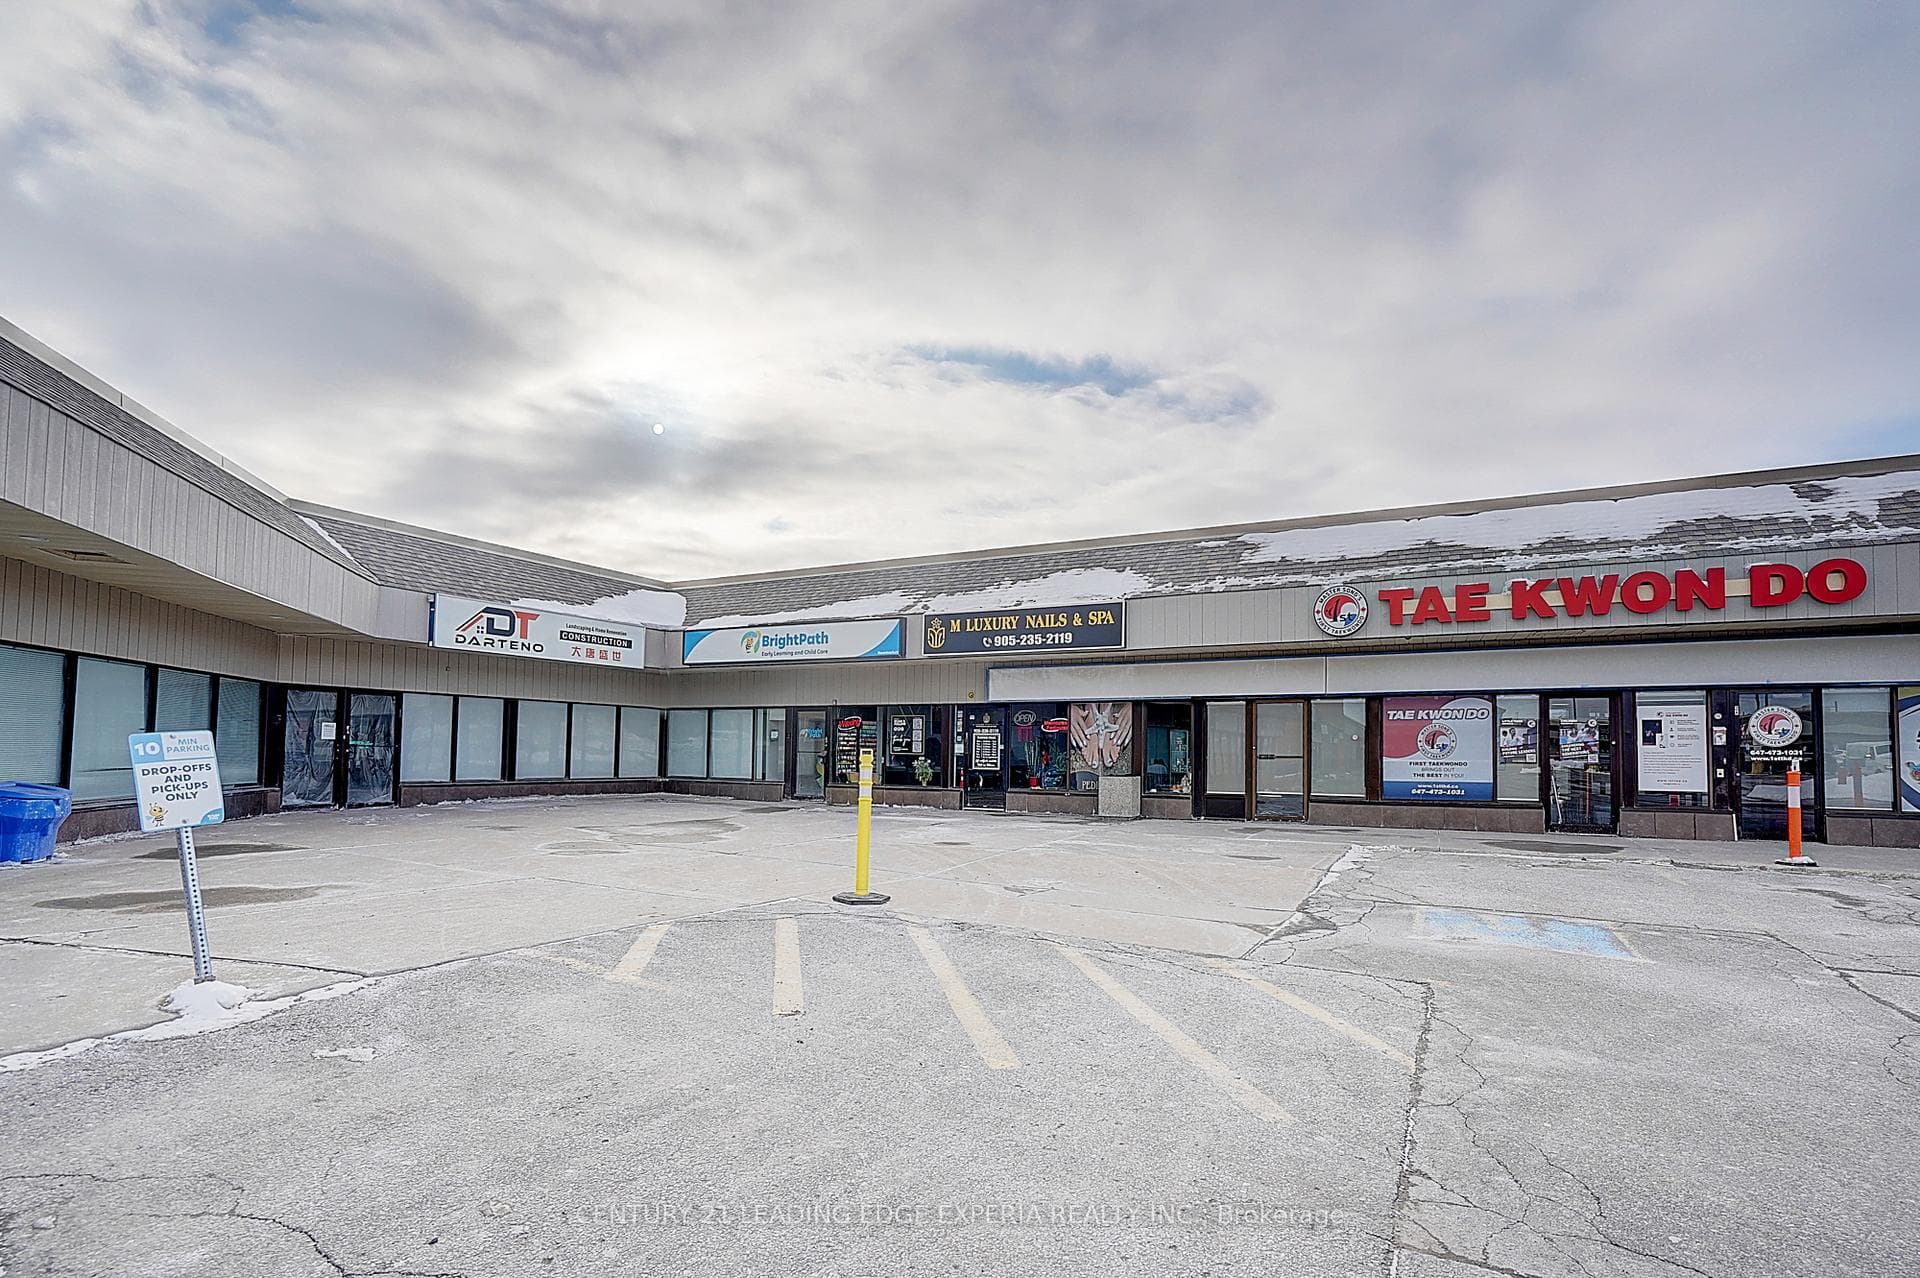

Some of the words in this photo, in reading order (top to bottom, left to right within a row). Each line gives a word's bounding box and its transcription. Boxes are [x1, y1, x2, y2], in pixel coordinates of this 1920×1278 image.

[1378, 582, 1490, 626] TAE
[1511, 566, 1726, 620] KWON
[1750, 557, 1868, 608] DO
[949, 619, 961, 633] M
[966, 615, 1020, 632] LUXURY
[1025, 613, 1067, 629] NAILS
[1072, 612, 1083, 627] &
[1088, 610, 1115, 626] SPA
[455, 634, 545, 653] DARTENO
[561, 631, 628, 648] CONSTRUCTION
[762, 631, 829, 650] BrightPath
[994, 632, 1073, 647] 905-235-2119
[1015, 713, 1034, 723] OPEN
[1387, 709, 1415, 720] TAE
[1417, 709, 1463, 720] KWON
[1466, 708, 1490, 720] DO
[1754, 708, 1775, 720] MASTER
[177, 737, 198, 745] MIN
[134, 742, 160, 756] 10
[166, 744, 210, 753] PARKING
[141, 763, 212, 777] DROP-OFFS
[164, 774, 192, 784] AND
[151, 781, 209, 794] PICK-UPS
[165, 791, 199, 802] ONLY
